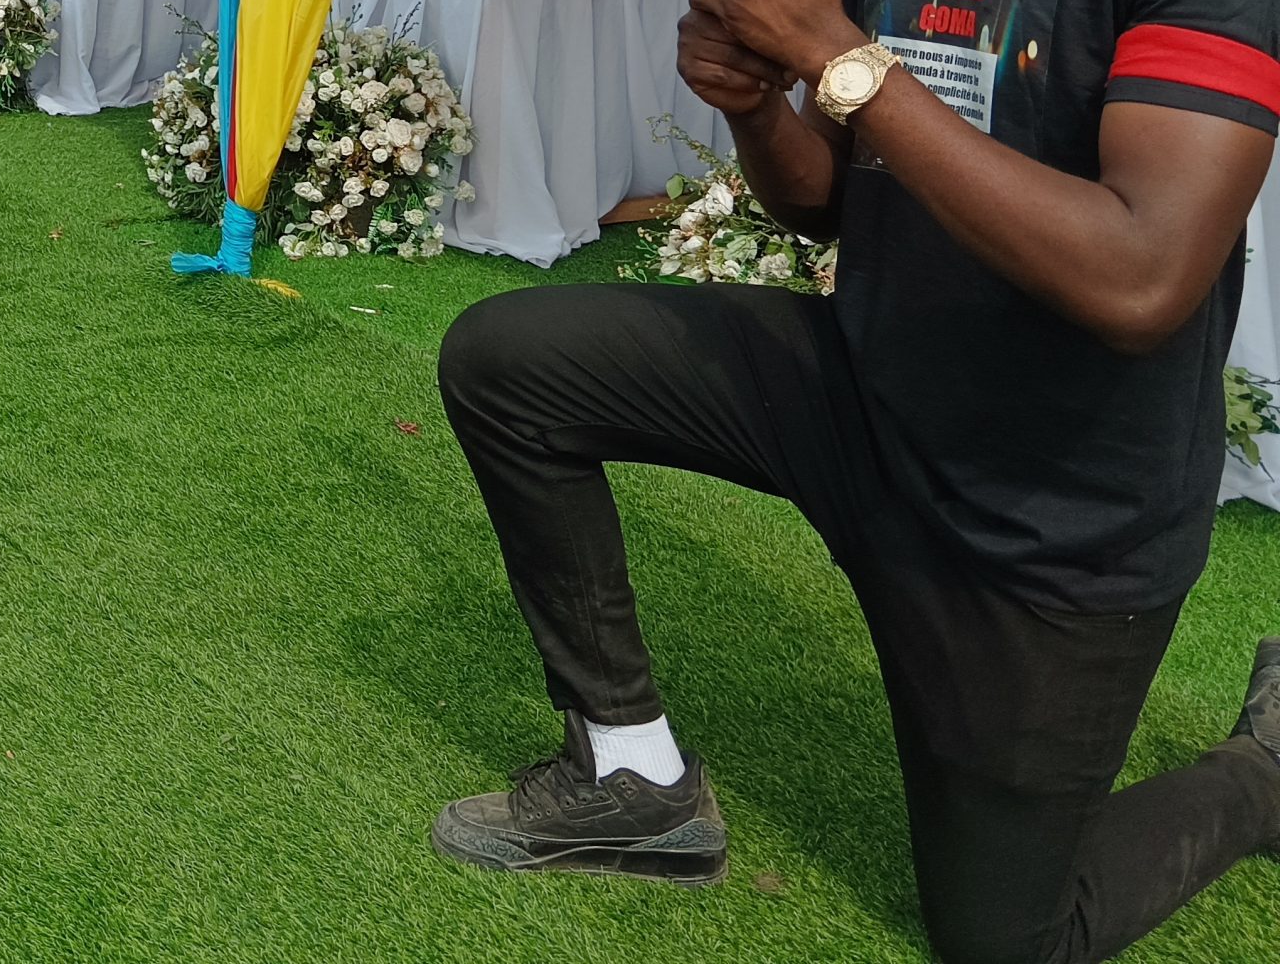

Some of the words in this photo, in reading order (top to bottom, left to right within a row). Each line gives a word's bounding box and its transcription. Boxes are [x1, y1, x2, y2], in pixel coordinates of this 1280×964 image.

[919, 3, 976, 37] GOMA
[918, 50, 943, 63] nous
[903, 61, 938, 79] Rwanda
